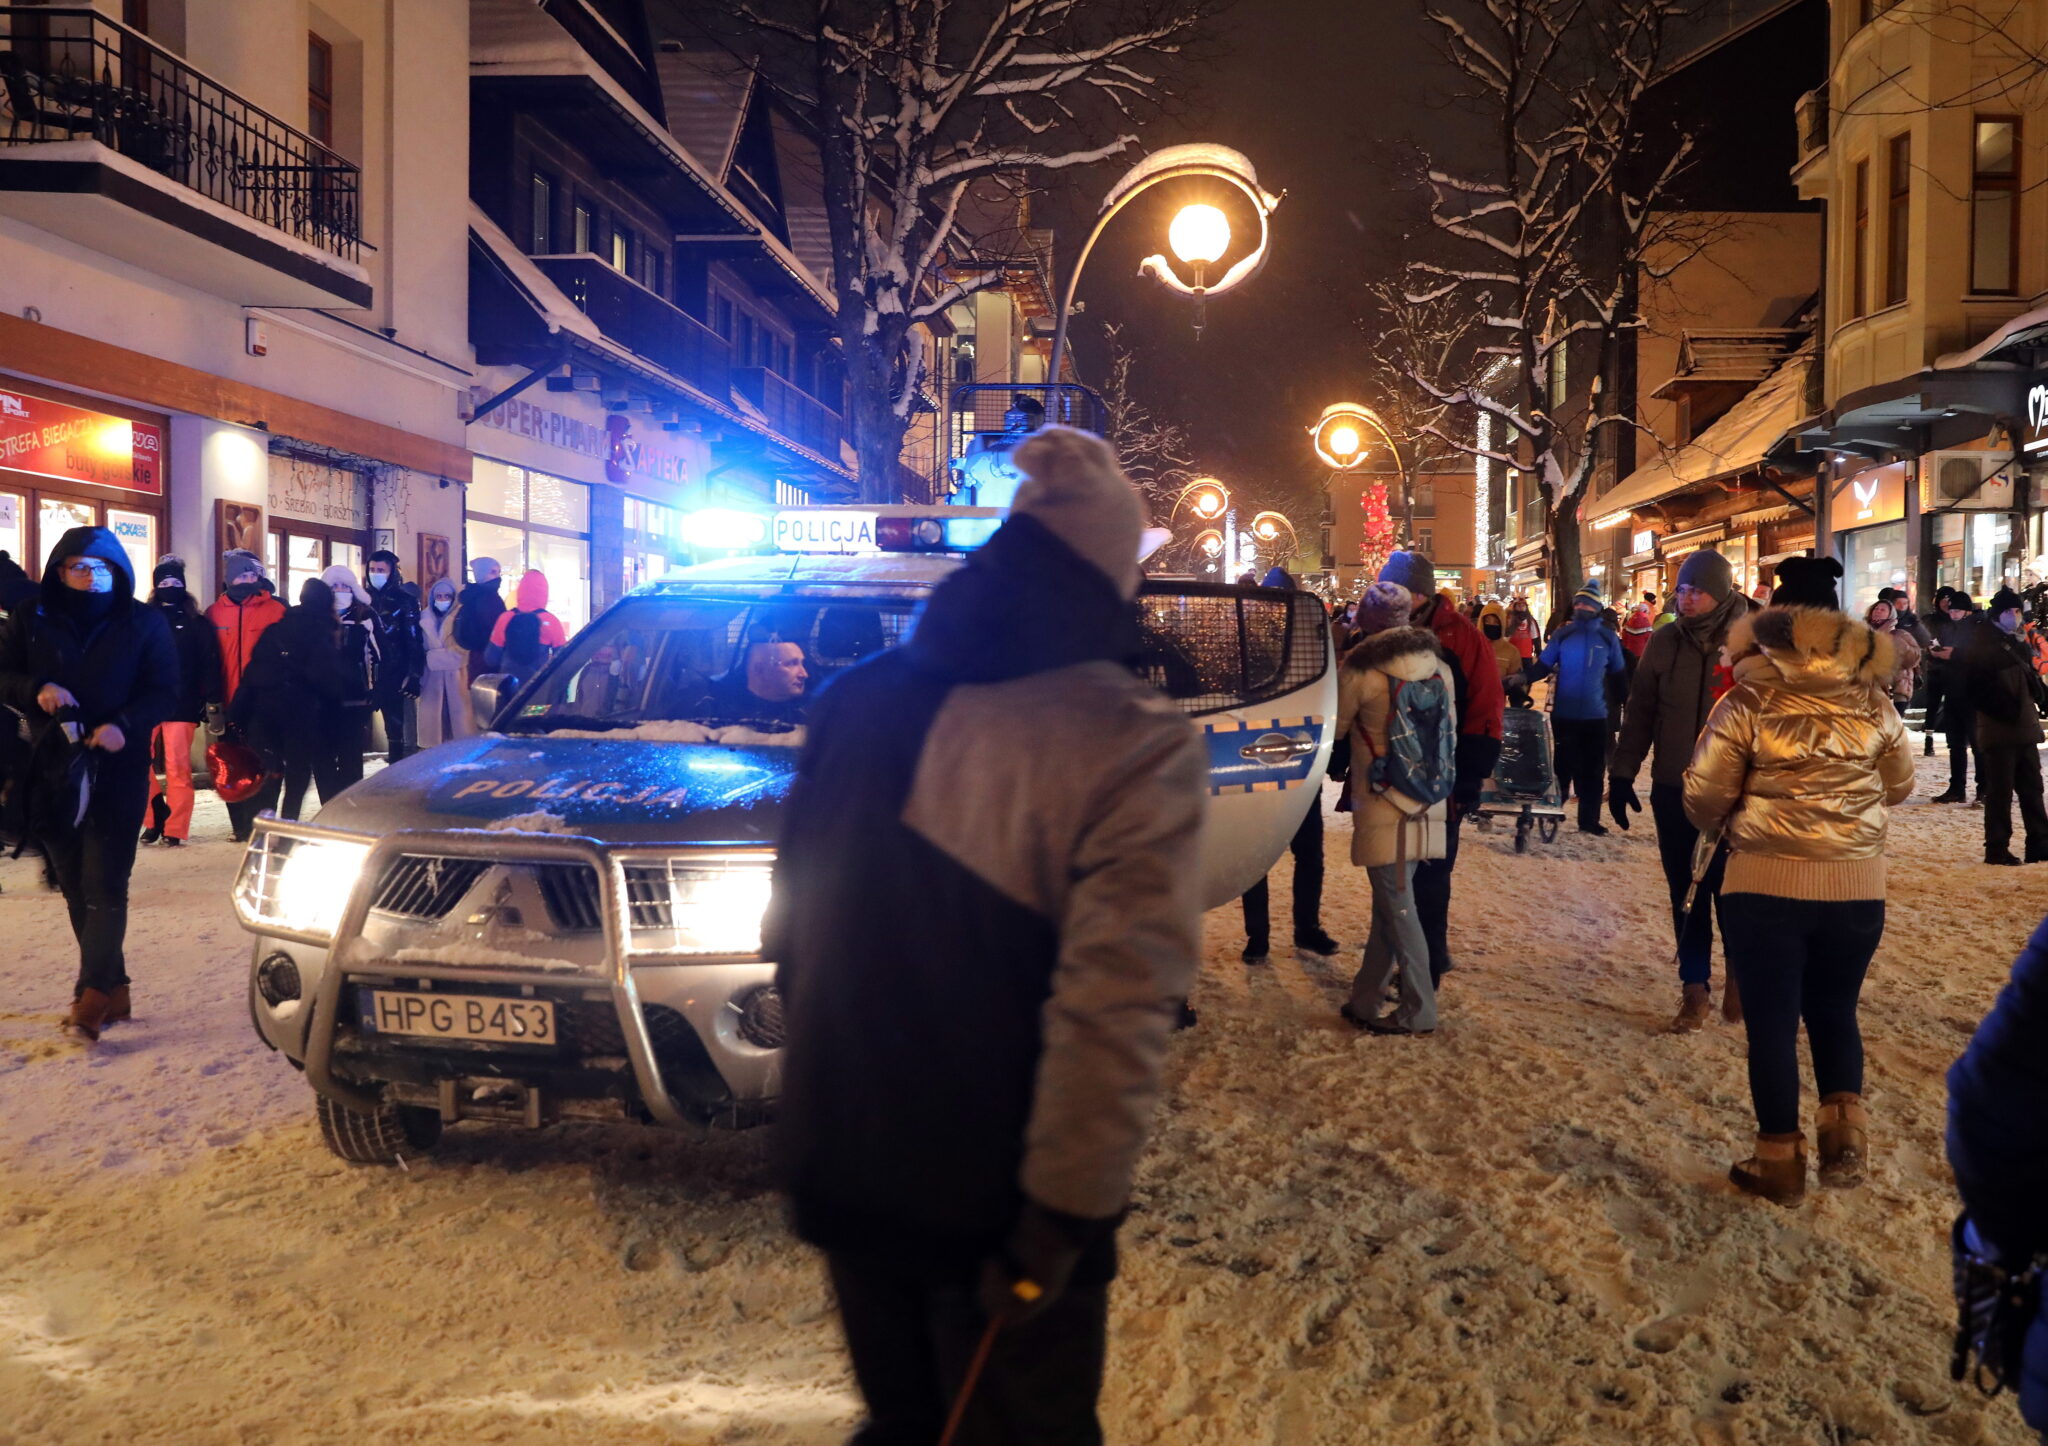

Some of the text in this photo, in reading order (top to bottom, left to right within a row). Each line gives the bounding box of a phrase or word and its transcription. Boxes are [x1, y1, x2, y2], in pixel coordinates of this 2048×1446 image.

[636, 446, 688, 484] APTEKA
[284, 496, 317, 515] SREBRO
[778, 519, 872, 543] POLICJA
[452, 778, 688, 808] POLICJA
[380, 997, 549, 1038] HPG B453
